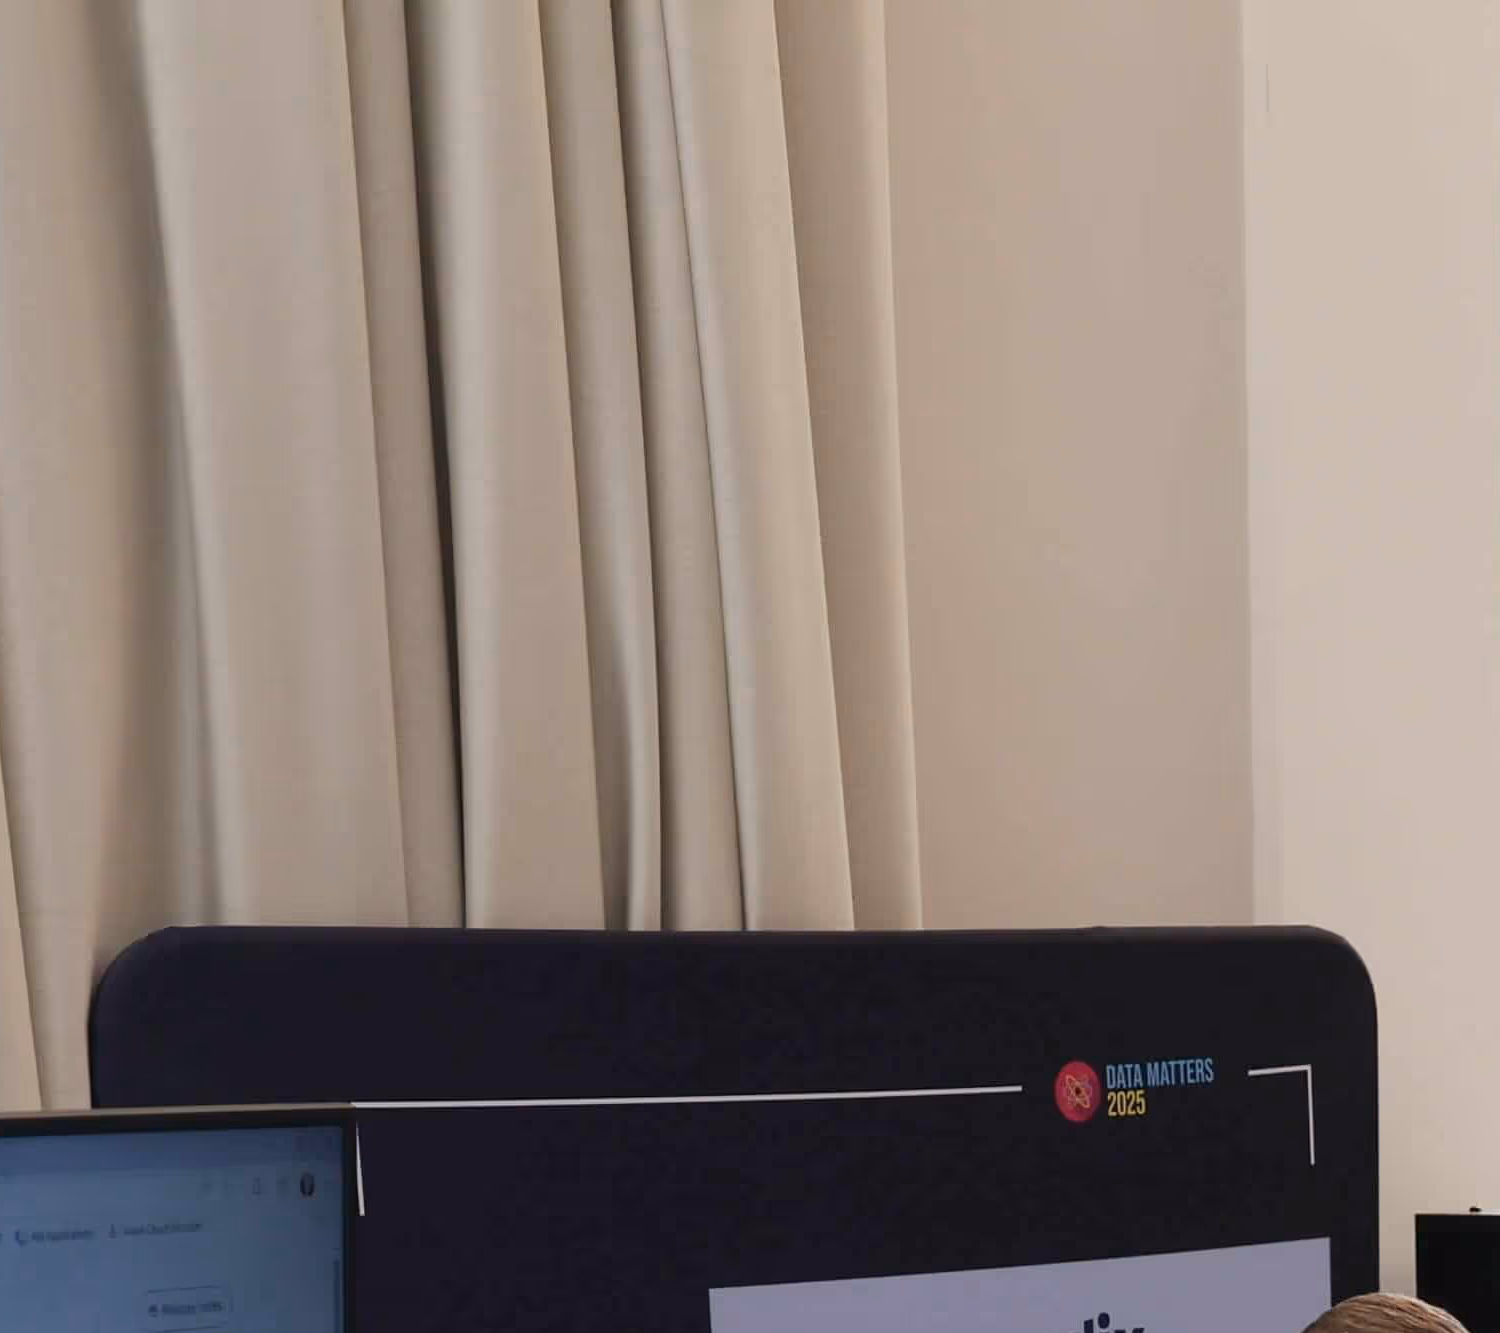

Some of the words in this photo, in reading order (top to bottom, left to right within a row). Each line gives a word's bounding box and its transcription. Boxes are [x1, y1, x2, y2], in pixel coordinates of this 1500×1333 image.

[1106, 1063, 1143, 1089] DATA
[1147, 1057, 1215, 1087] MATTERS
[1107, 1089, 1146, 1117] 2025
